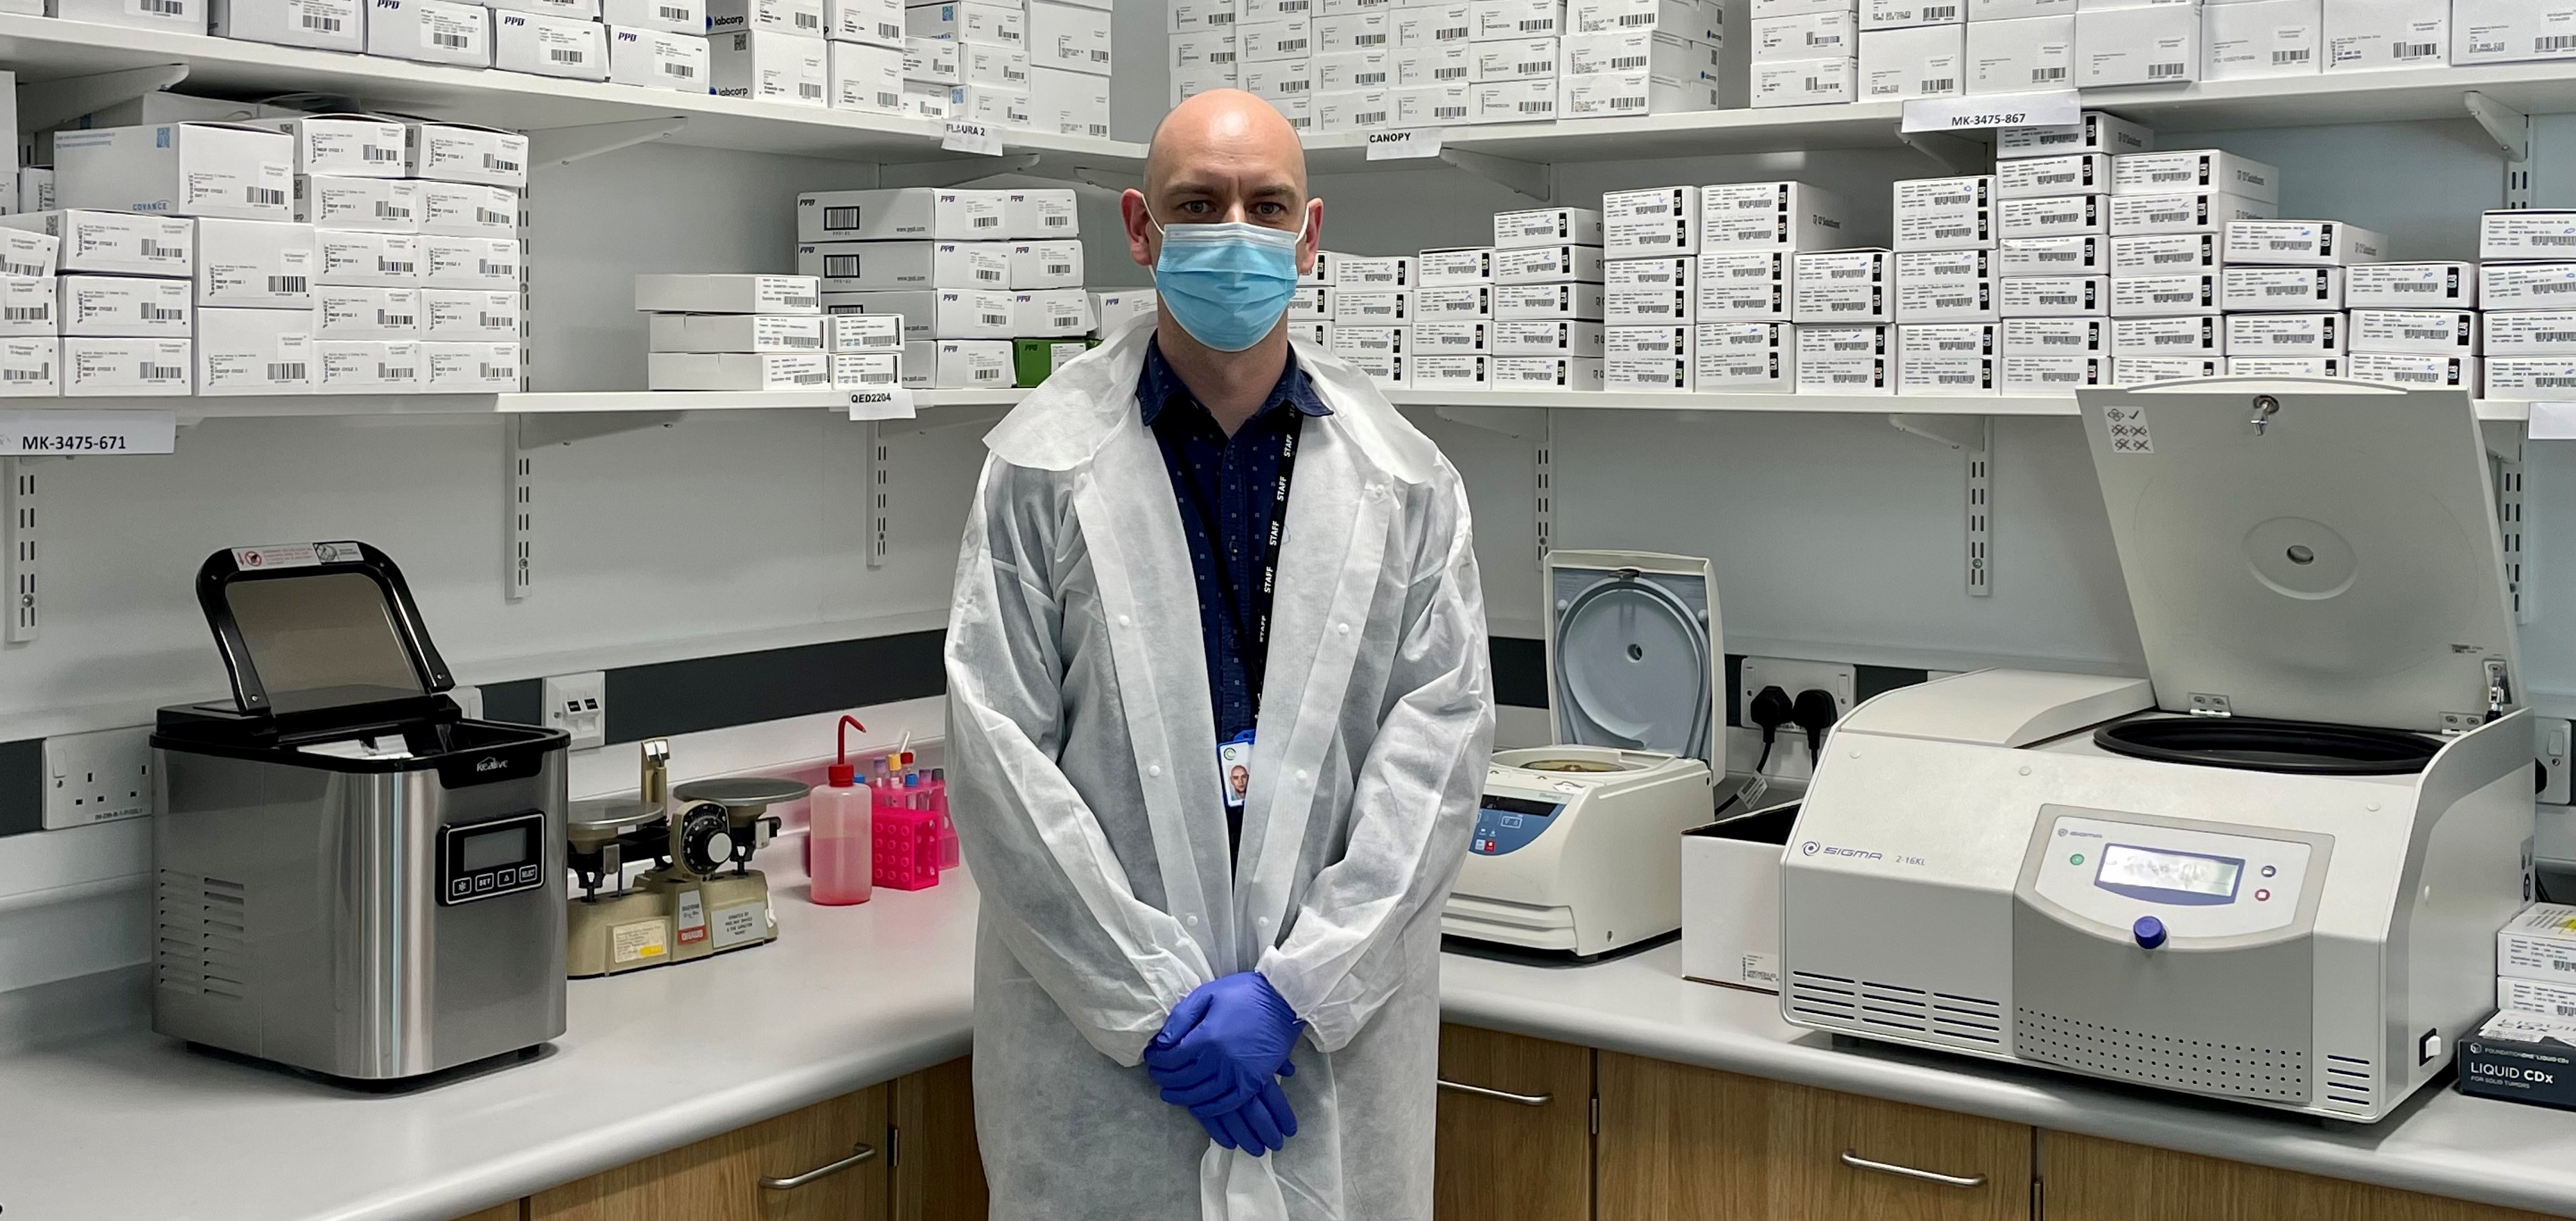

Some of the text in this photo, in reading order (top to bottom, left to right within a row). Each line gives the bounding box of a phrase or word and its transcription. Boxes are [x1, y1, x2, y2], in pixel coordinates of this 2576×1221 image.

[504, 15, 525, 26] PPD
[714, 15, 744, 26] labcorp
[618, 32, 638, 42] PPD
[719, 86, 748, 96] labcorp
[1952, 113, 2026, 125] MK-3475-867
[980, 128, 985, 137] 2
[1369, 132, 1411, 143] CANOPY
[132, 202, 167, 211] COVANCE
[851, 392, 891, 403] QED2204
[22, 436, 126, 450] MK-3475-671
[1283, 434, 1293, 457] STAFF
[1277, 475, 1286, 501] STAFF
[1269, 520, 1279, 546] STAFF
[1264, 566, 1273, 594] STAFF
[2069, 831, 2103, 839] SIGMA
[1823, 846, 1925, 867] SIGMA 2-16KL
[479, 878, 490, 886] SET
[2471, 1062, 2554, 1084] LIQUID CDx
[2471, 1075, 2484, 1083] FOR
[2485, 1077, 2503, 1085] SOLID
